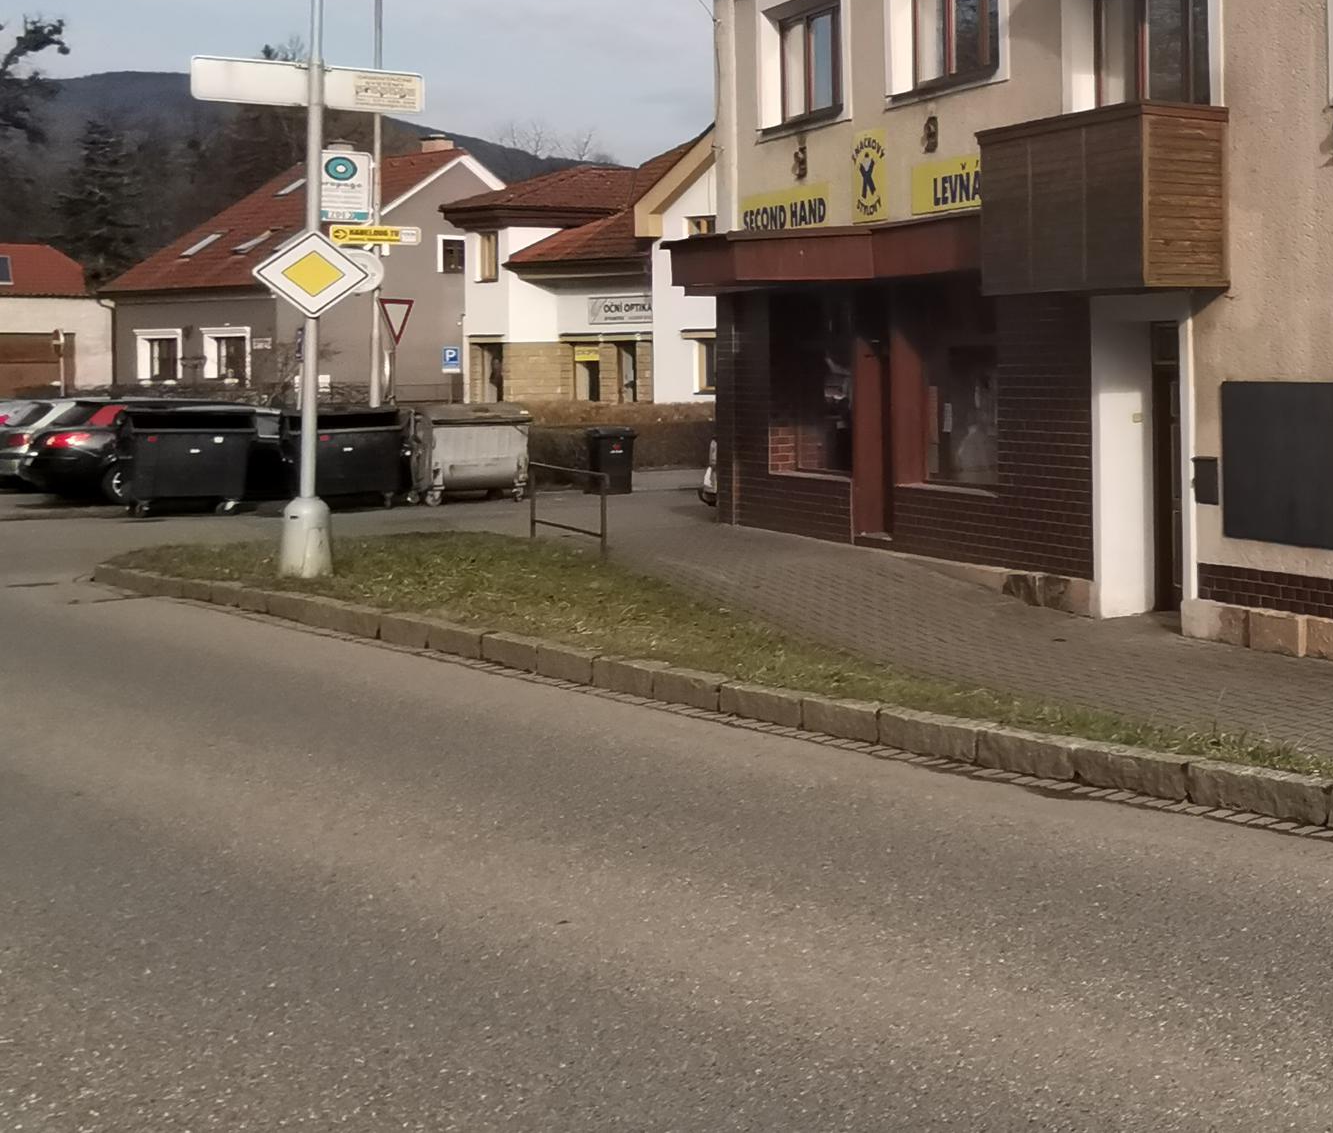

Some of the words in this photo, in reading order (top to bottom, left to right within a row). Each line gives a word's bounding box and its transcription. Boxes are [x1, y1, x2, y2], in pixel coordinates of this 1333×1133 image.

[743, 204, 786, 231] SECOND
[790, 197, 826, 227] HAND
[623, 302, 653, 313] OPTIKA
[445, 349, 457, 362] P
